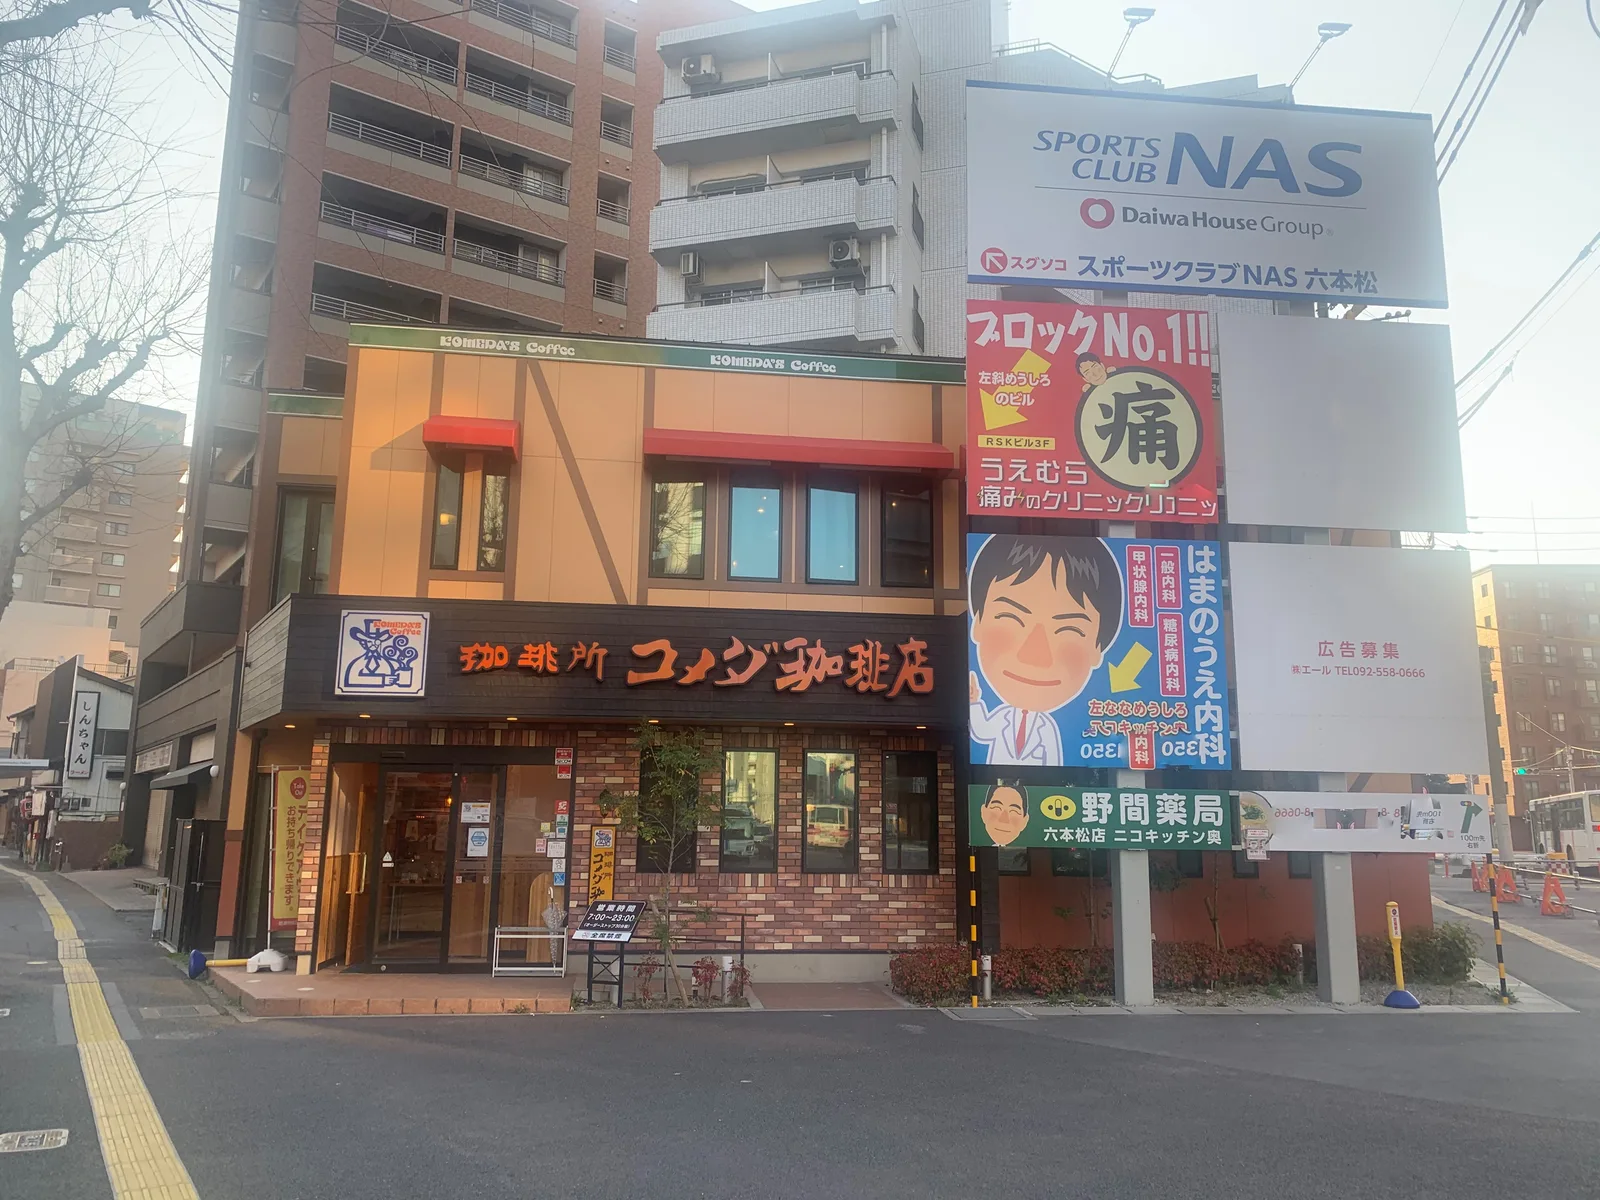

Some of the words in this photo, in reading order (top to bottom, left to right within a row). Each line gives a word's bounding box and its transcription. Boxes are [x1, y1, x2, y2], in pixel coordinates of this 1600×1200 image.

[1033, 130, 1161, 158] SPORTS
[1072, 158, 1157, 183] CLUB
[1165, 132, 1363, 197] NAS
[1122, 207, 1188, 227] Daiwa
[1192, 211, 1257, 230] House
[1261, 215, 1324, 240] Group
[1011, 255, 1067, 273] スグソコ
[1077, 254, 1297, 288] スポーツクラブNAS
[1304, 267, 1378, 295] 六本松
[440, 336, 520, 351] KOMEDA'S
[526, 342, 575, 356] Coffee
[711, 355, 785, 369] KOMEDA'S
[790, 360, 836, 373] Coffee
[979, 371, 1051, 387] 左斜めうしろ
[995, 392, 1035, 406] のビル
[1094, 380, 1180, 471] 痛
[980, 457, 1088, 485] うえむら
[1132, 551, 1149, 622] 甲状腺内科
[1160, 551, 1176, 603] 一般内科
[389, 628, 421, 636] Coffee
[459, 641, 610, 682] 珈琲所
[1163, 618, 1180, 692] 糖尿病内科
[1187, 544, 1226, 765] はまのうえ内科
[1318, 640, 1400, 659] 広告募集
[626, 635, 935, 699] コメダ珈琲店
[1334, 665, 1426, 678] TEL092-558-0666
[1089, 699, 1188, 718] 左ななめうしろ
[75, 701, 91, 764] しんちゃん
[1081, 792, 1224, 827] 野間薬局
[1043, 827, 1106, 843] 六本松店
[1114, 829, 1222, 845] ニコキッチン奥
